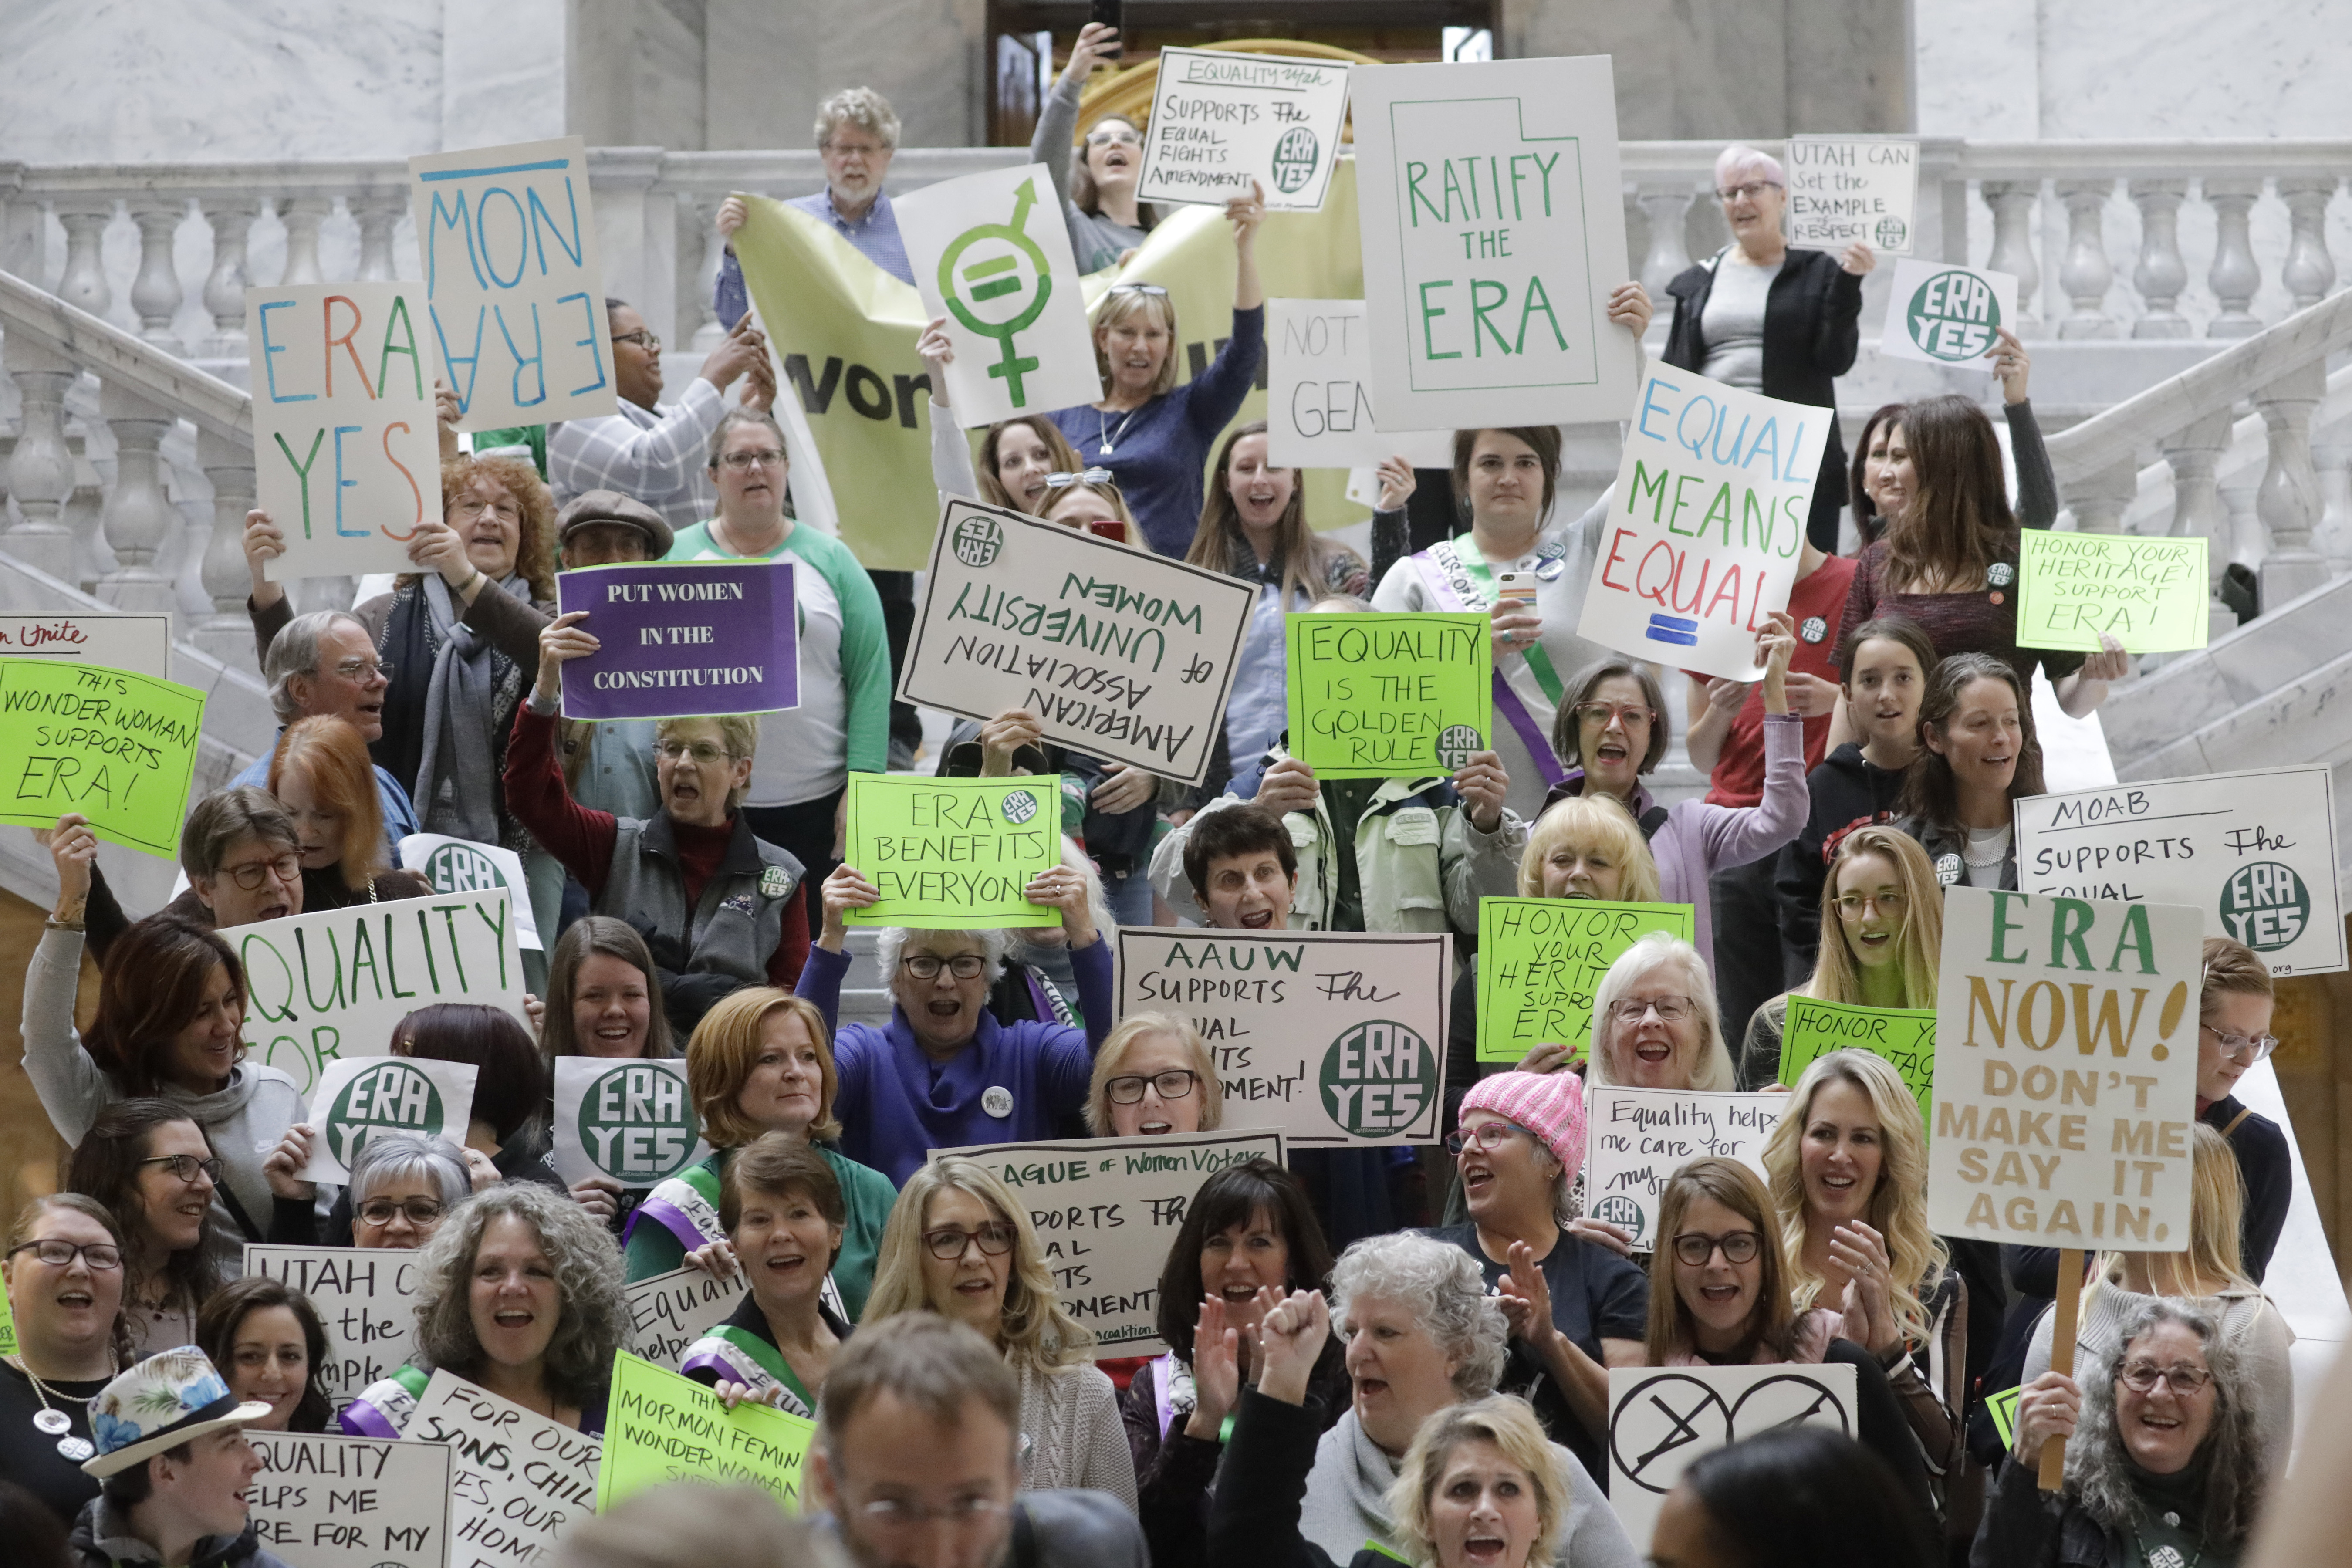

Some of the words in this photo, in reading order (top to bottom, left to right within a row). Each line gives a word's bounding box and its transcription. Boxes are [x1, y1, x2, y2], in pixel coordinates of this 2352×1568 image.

[1187, 60, 1279, 84] EQUALITY
[1281, 68, 1332, 87] Utah
[1162, 95, 1259, 124] SUPPORTS
[1271, 101, 1310, 122] The
[1161, 126, 1227, 144] EQUAL
[1280, 128, 1314, 161] ERA
[1159, 145, 1229, 162] RIGHTS
[1792, 144, 1855, 166] UTAH
[1868, 145, 1909, 165] CAN
[1149, 166, 1251, 188] AMENDMENT
[1274, 161, 1313, 189] YES
[1407, 152, 1560, 228] RATIFY
[1832, 172, 1868, 190] the
[1793, 196, 1886, 215] EXAMPLE
[427, 177, 581, 301] NOW
[1794, 223, 1869, 240] RESPECT
[1876, 233, 1905, 247] YES
[1879, 217, 1904, 233] ERA
[1460, 229, 1513, 259] THE
[1923, 274, 1990, 323] ERA
[1419, 276, 1568, 360] ERA
[260, 295, 423, 402] ERA
[1283, 315, 1360, 355] NOT
[1914, 315, 1990, 358] YES
[429, 292, 606, 413] ERA
[1639, 378, 1811, 484] EQUAL
[274, 421, 422, 541] YES
[1628, 459, 1804, 558] MEANS
[958, 519, 1001, 545] YES
[956, 538, 996, 567] ERA
[2031, 537, 2111, 560] HONOR
[2128, 543, 2189, 566] YOUR
[1602, 527, 1766, 633] EQUAL
[1988, 573, 2011, 585] YES
[1990, 564, 2013, 575] ERA
[2038, 558, 2193, 585] HERITAGE!
[607, 585, 652, 603] PUT
[656, 582, 743, 602] WOMEN
[1059, 572, 1201, 635] WOMEN
[2054, 582, 2171, 603] SUPPORT
[21, 621, 88, 647] Unite
[640, 628, 662, 645] IN
[667, 626, 714, 644] THE
[948, 581, 1165, 673] UNIVERSITY
[1802, 628, 1824, 642] YES
[1806, 617, 1825, 629] ERA
[1312, 626, 1481, 665] EQUALITY
[78, 670, 127, 695] THIS
[594, 666, 763, 689] CONSTITUTION
[944, 635, 1152, 710] ASSOCIATION
[1327, 678, 1353, 700] IS
[1371, 675, 1437, 702] THE
[1312, 709, 1442, 740] GOLDEN
[1442, 726, 1478, 749] ERA
[36, 726, 162, 770] SUPPORTS
[1349, 736, 1428, 764] RULE
[1439, 749, 1473, 769] YE
[16, 755, 139, 811] ERA!
[912, 793, 993, 829] ERA
[1003, 790, 1029, 814] ERA
[1007, 802, 1037, 824] YES
[2051, 791, 2149, 827] MOAB
[874, 831, 1044, 862] BENEFITS
[1937, 855, 1958, 870] ERA
[2033, 838, 2194, 875] SUPPORTS
[2224, 825, 2296, 856] The
[436, 846, 496, 892] ERA
[764, 867, 789, 883] ERA
[1936, 871, 1959, 885] YES
[760, 881, 787, 896] YES
[2232, 863, 2296, 909] ERA
[1500, 906, 1638, 945] HONOR
[1985, 890, 2160, 975] ERA
[2226, 906, 2301, 946] YES
[241, 899, 507, 1023] QUALITY
[1165, 942, 1304, 973] AAUW
[1528, 941, 1608, 965] YOUR
[1137, 971, 1285, 1003] SUPPORTS
[1315, 971, 1400, 1002] The
[1796, 1008, 1887, 1043] HONOR
[1962, 975, 2188, 1062] NOW!
[1339, 1024, 1422, 1079] ERA
[346, 1065, 431, 1125] ERA
[599, 1068, 683, 1122] ERA
[1983, 1058, 2158, 1111] DON'T
[1328, 1084, 1423, 1129] YES
[1611, 1100, 1716, 1145] Equality
[1601, 1135, 1631, 1152] me
[1640, 1137, 1693, 1157] care
[1708, 1139, 1746, 1157] for
[1937, 1102, 2088, 1151] MAKE
[2112, 1119, 2189, 1158] ME
[587, 1125, 688, 1172] YES
[1125, 1152, 1188, 1175] Women
[1605, 1165, 1660, 1195] my
[1957, 1148, 2061, 1190] SAY
[2115, 1160, 2164, 1197] IT
[1599, 1196, 1637, 1222] ERA
[1964, 1192, 2169, 1242] AGAIN.
[261, 1257, 375, 1297] UTAH
[338, 1307, 405, 1344] the
[443, 1387, 520, 1439] FOR
[621, 1390, 723, 1446] MORMON
[250, 1441, 392, 1479] QUALITY
[531, 1426, 602, 1480] OUR
[329, 1489, 378, 1514] ME
[504, 1497, 566, 1539] OUR
[314, 1523, 368, 1549] FOR
[385, 1526, 430, 1551] MY
